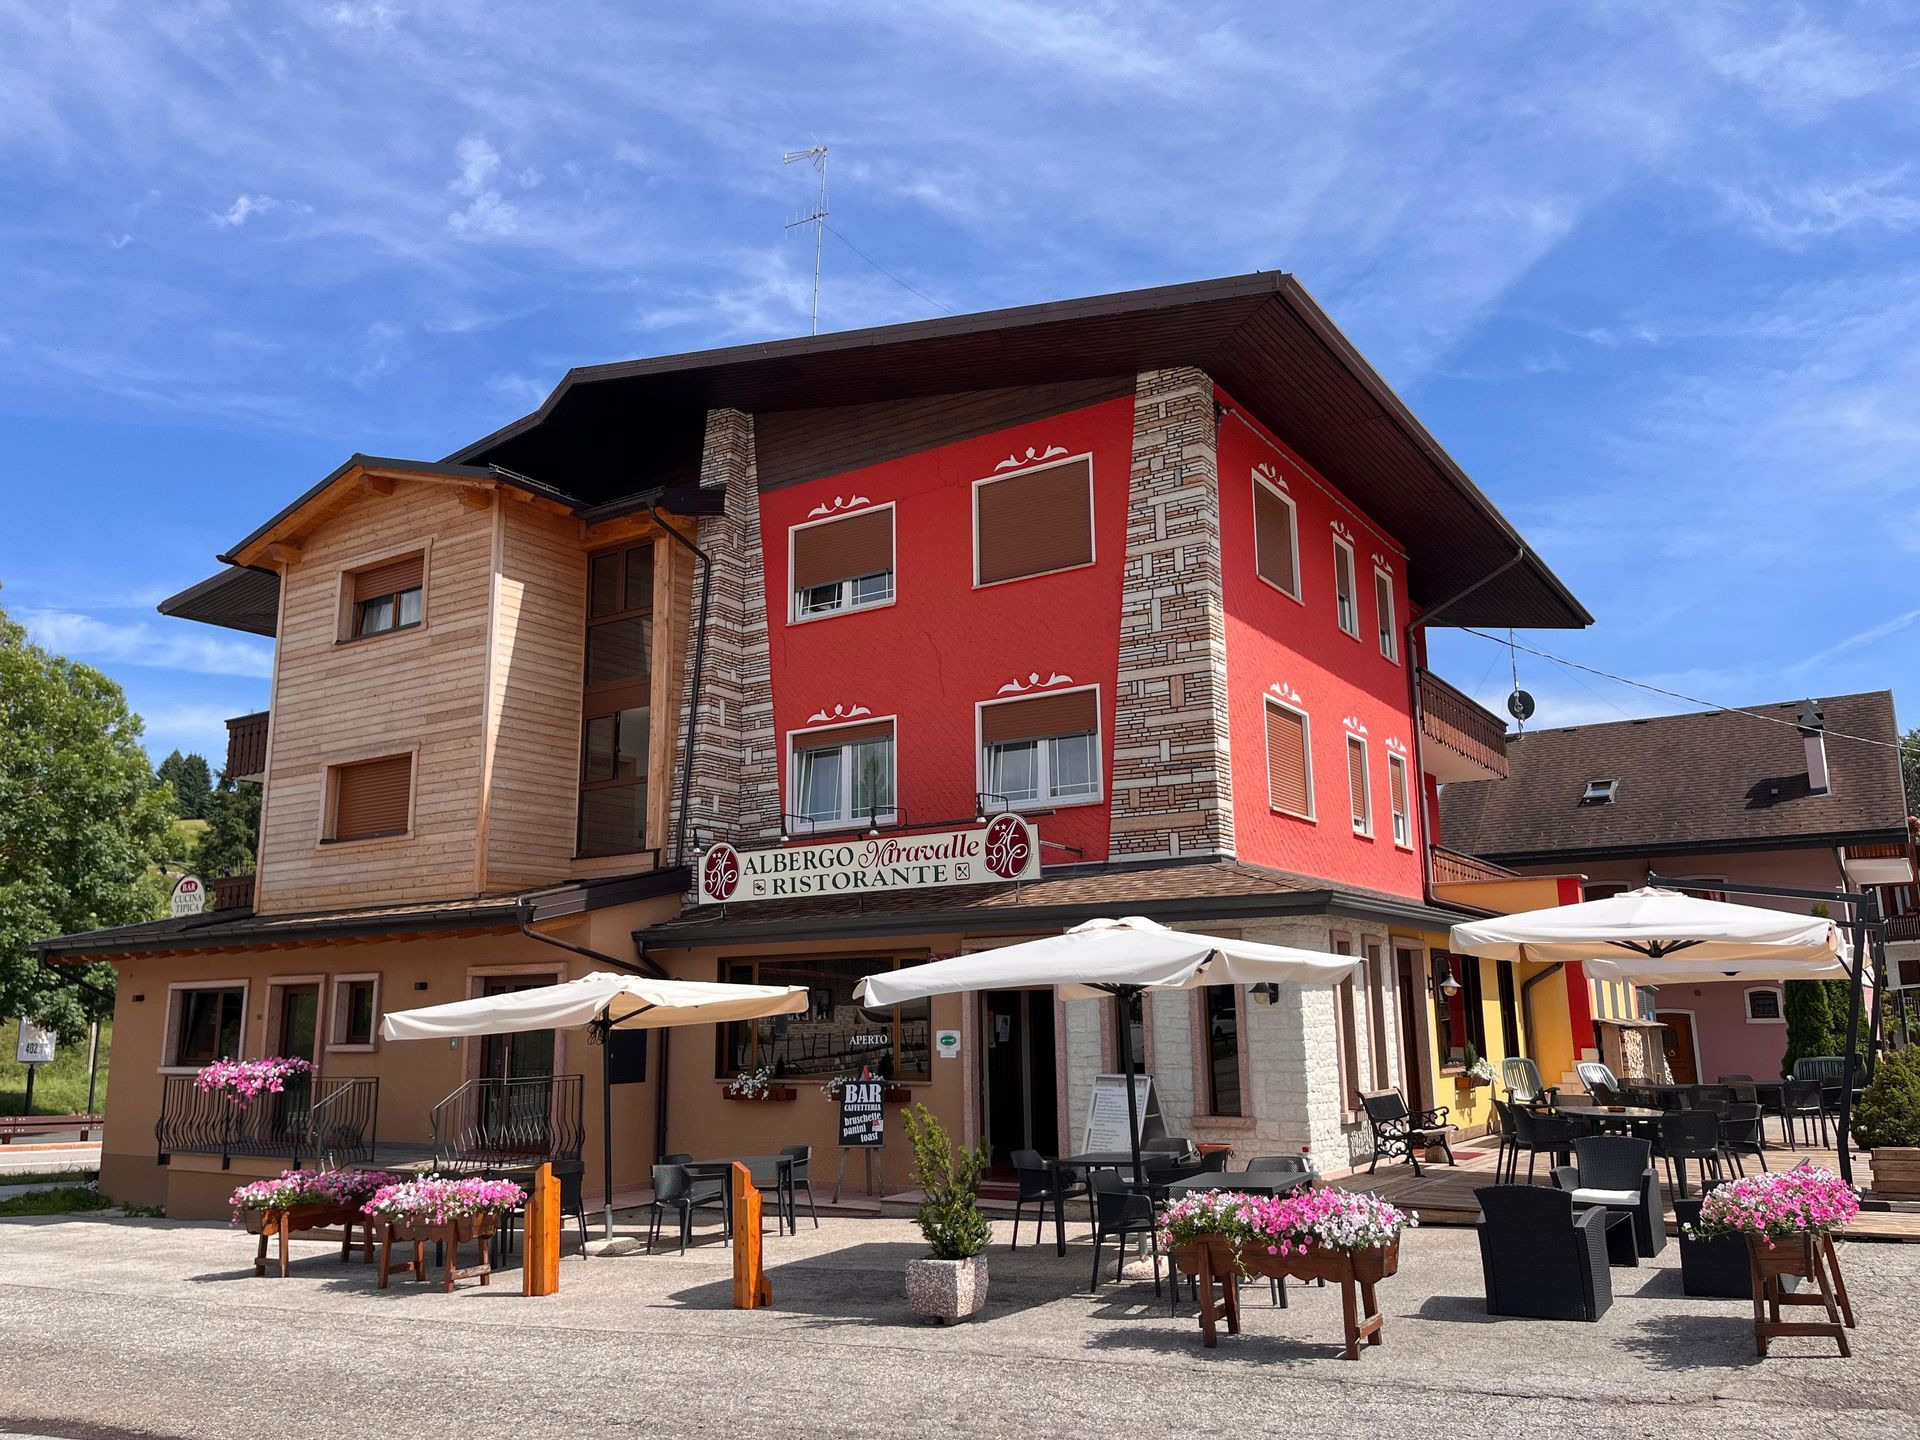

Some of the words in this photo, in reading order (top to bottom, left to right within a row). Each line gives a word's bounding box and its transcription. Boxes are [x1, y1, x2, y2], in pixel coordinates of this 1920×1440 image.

[743, 846, 854, 876] ALBERGO
[857, 833, 980, 869] Miravalle
[772, 864, 948, 895] RISTORANTE
[182, 882, 196, 892] BAR
[174, 893, 202, 904] CUCINA
[176, 903, 200, 913] TIPICA
[849, 1034, 888, 1045] APERTO
[844, 1083, 882, 1104] BAR
[844, 1103, 881, 1112] CAFFETTERIA
[844, 1112, 881, 1126] bruschette
[843, 1123, 867, 1137] panini
[860, 1131, 878, 1142] toast
